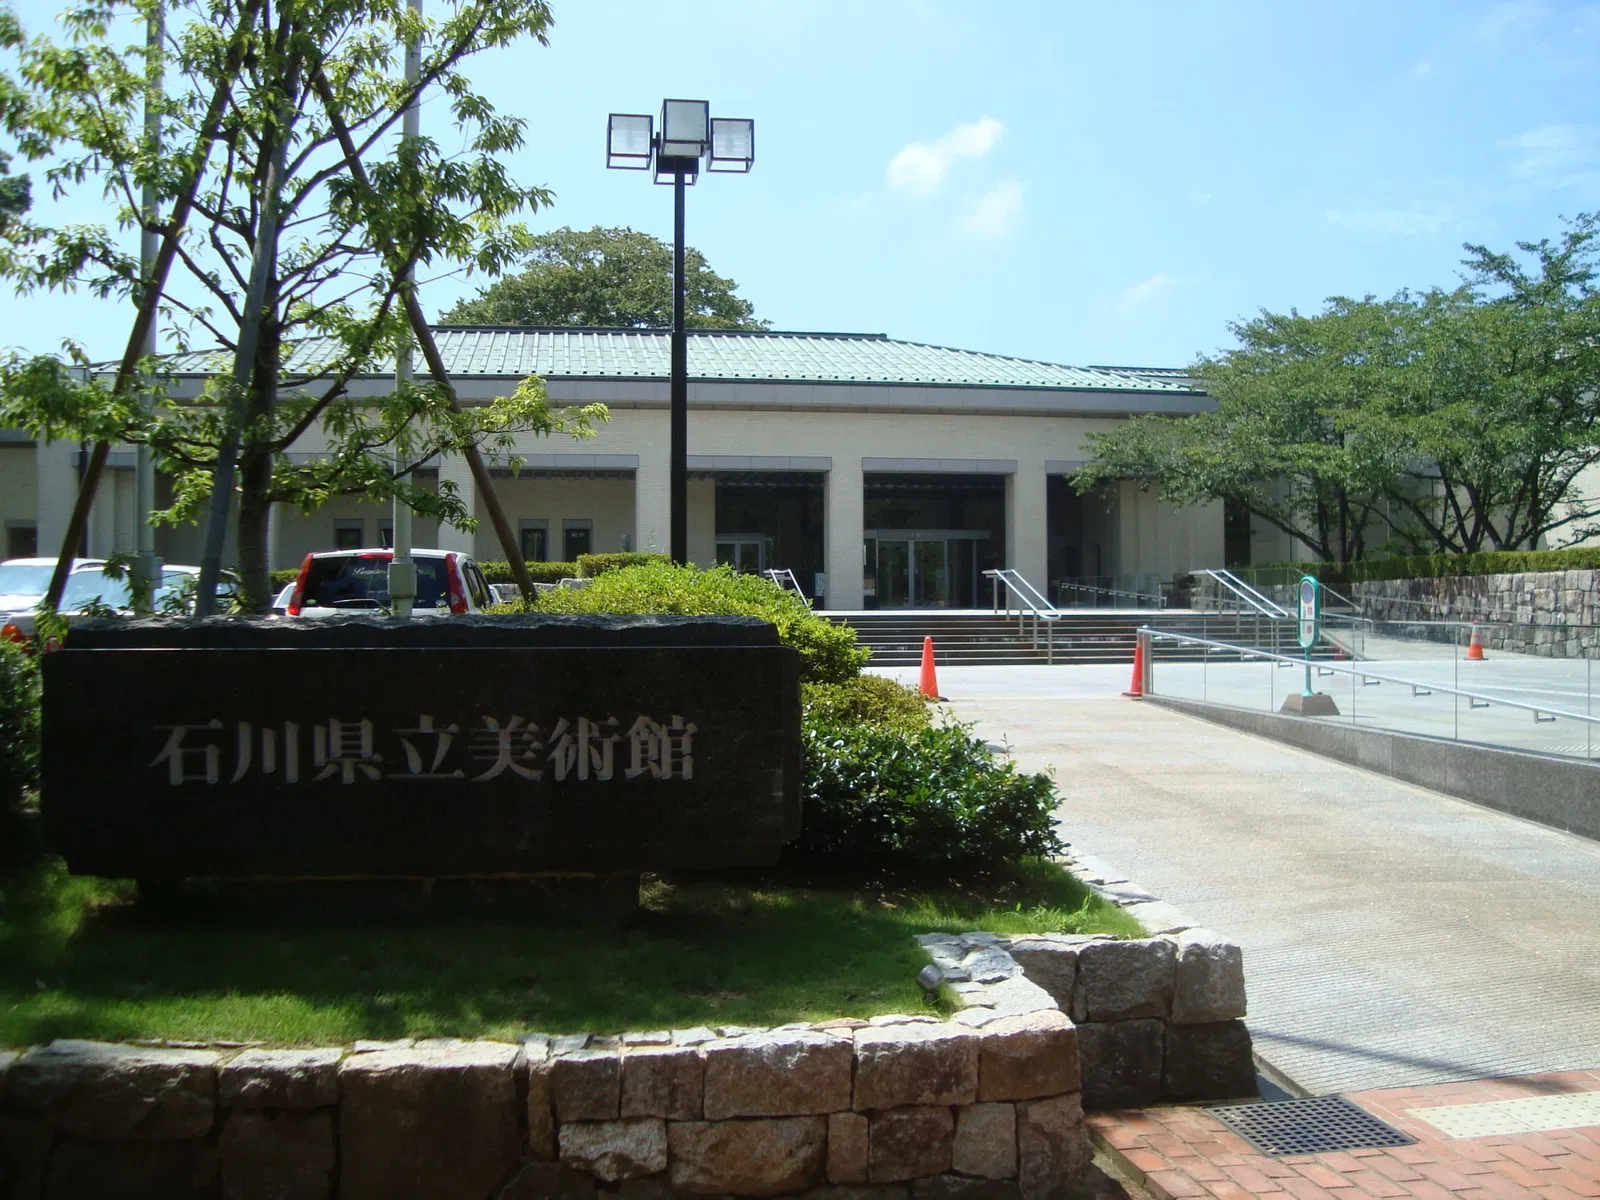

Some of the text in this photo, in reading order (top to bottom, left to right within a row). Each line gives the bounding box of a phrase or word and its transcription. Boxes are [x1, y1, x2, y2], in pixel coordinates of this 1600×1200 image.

[148, 714, 699, 786] 石川県立美術館
